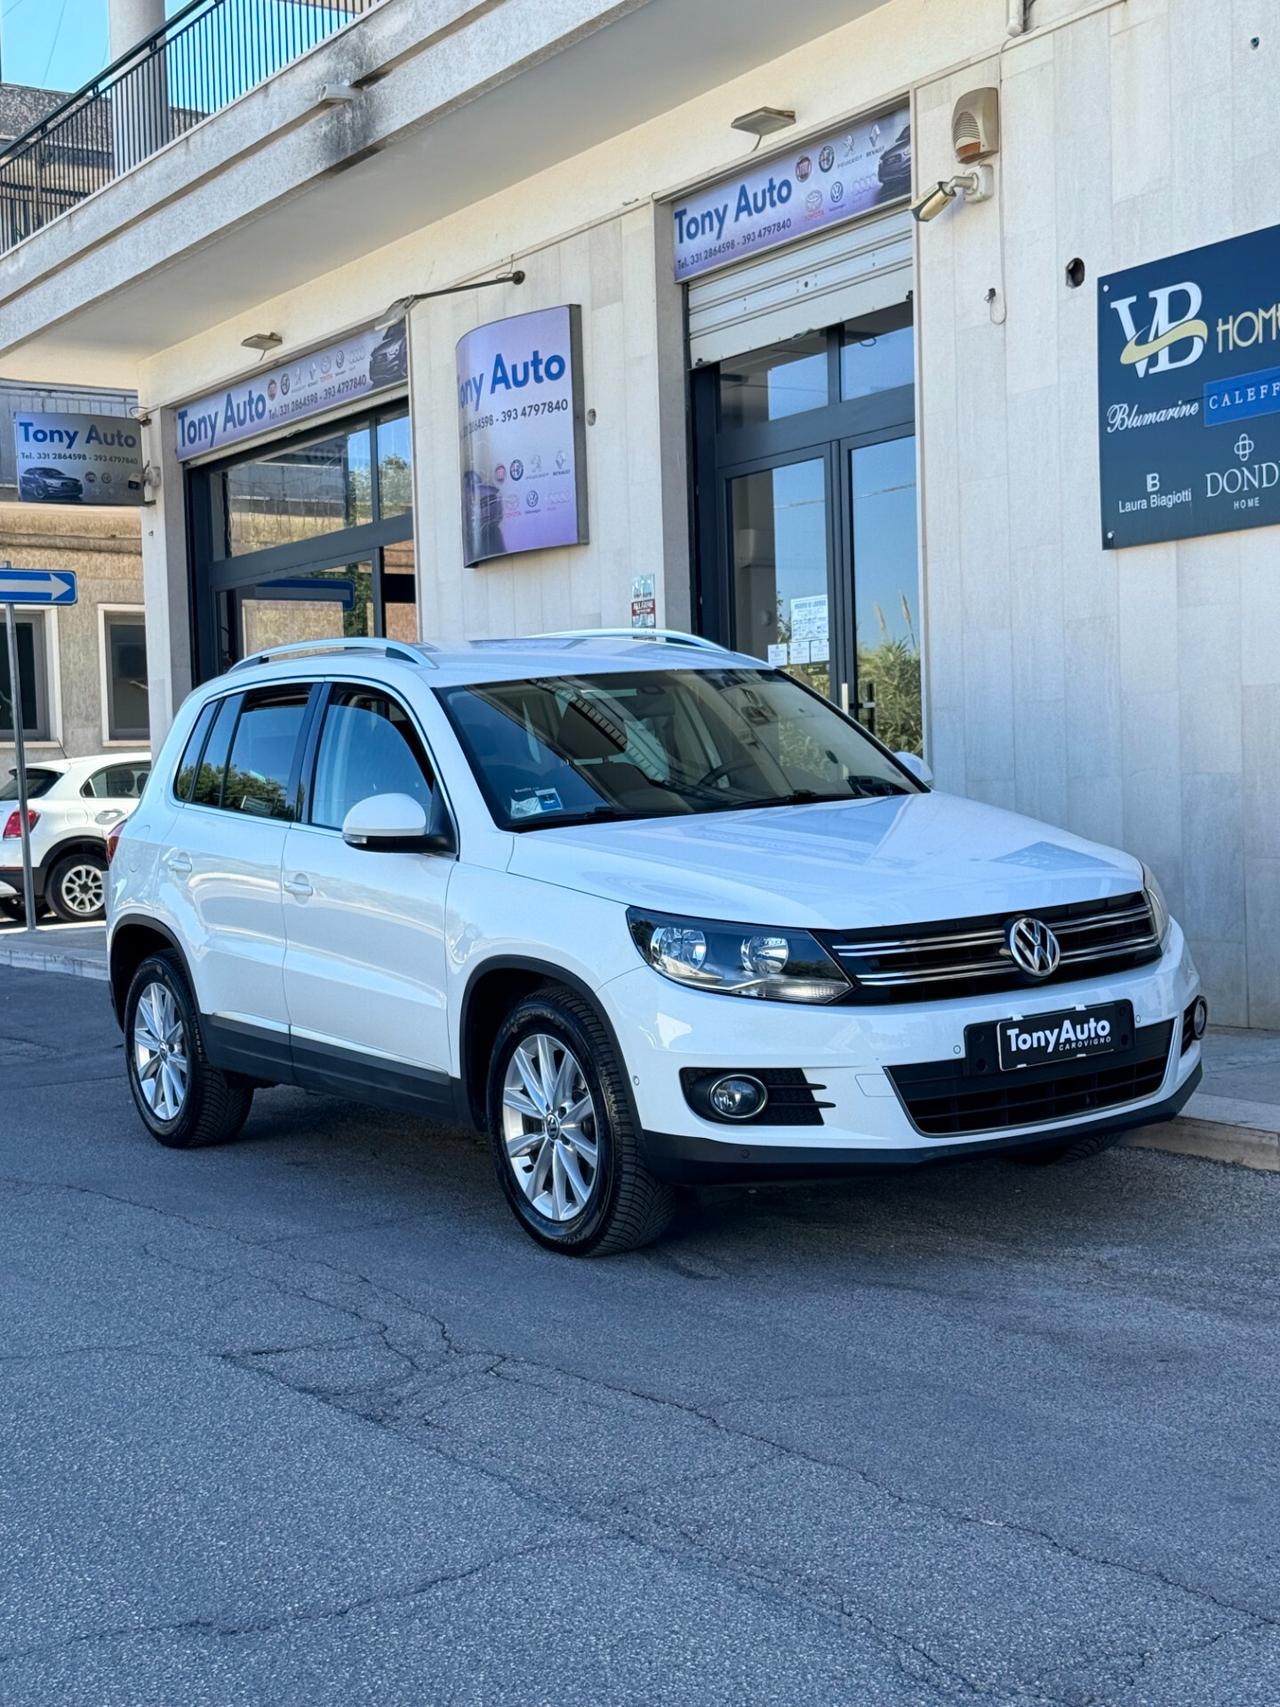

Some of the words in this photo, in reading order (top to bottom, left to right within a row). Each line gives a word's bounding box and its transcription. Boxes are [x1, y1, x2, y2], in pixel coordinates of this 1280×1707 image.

[674, 203, 728, 244] Tony
[734, 177, 792, 223] Auto
[690, 251, 703, 266] 331
[742, 231, 756, 246] 393
[757, 218, 792, 238] 4797840
[323, 386, 336, 400] 393
[460, 373, 484, 412] ony
[490, 350, 566, 394] Auto
[178, 409, 219, 448] Tony
[223, 390, 266, 432] Auto
[501, 408, 518, 423] 393
[520, 399, 568, 418] 4797840
[1107, 400, 1199, 433] Blumarine
[19, 422, 79, 449] Tony
[85, 424, 137, 448] Auto
[1205, 461, 1280, 498] DOND
[1119, 497, 1147, 513] Laura
[1150, 488, 1192, 508] Biagiotti
[1233, 497, 1260, 510] HOME
[1006, 1018, 1111, 1053] TonyAuto
[1059, 1036, 1111, 1051] CAROVIGNO
